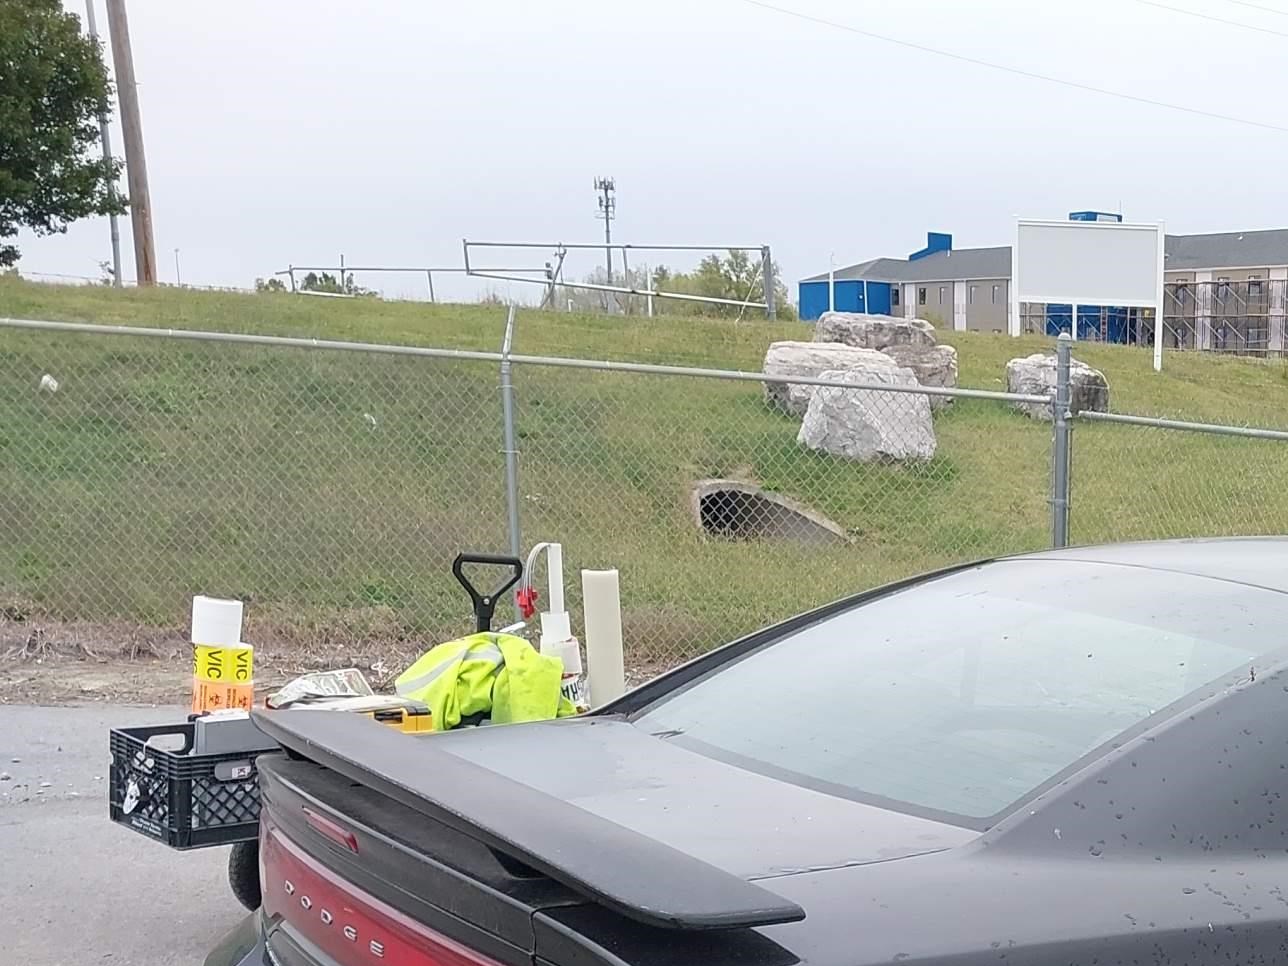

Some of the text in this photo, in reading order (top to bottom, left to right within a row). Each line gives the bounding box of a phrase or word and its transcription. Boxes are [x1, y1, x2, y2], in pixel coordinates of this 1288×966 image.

[207, 650, 222, 679] VIC
[235, 651, 248, 680] VIC
[284, 879, 385, 958] DODGE
